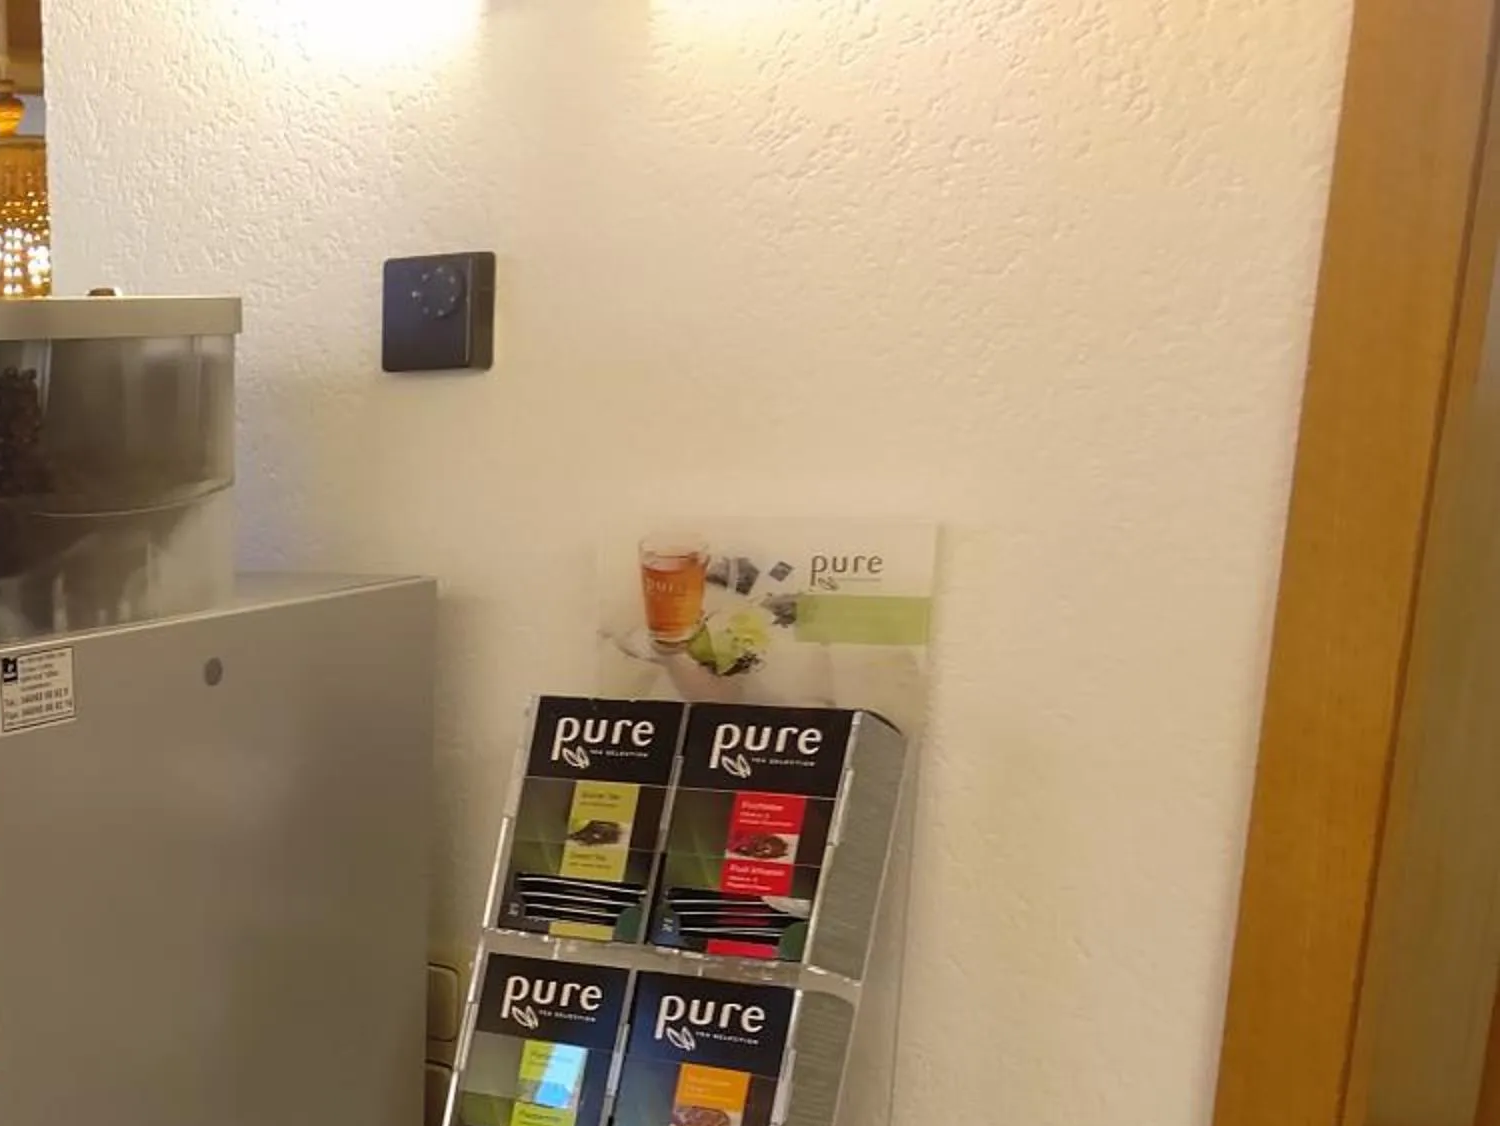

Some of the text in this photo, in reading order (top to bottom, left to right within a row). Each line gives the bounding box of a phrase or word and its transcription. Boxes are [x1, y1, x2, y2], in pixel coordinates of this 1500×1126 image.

[810, 555, 884, 587] pure
[551, 717, 655, 761] pure
[709, 723, 823, 769] pure
[501, 975, 603, 1019] pure
[655, 995, 766, 1040] pure
